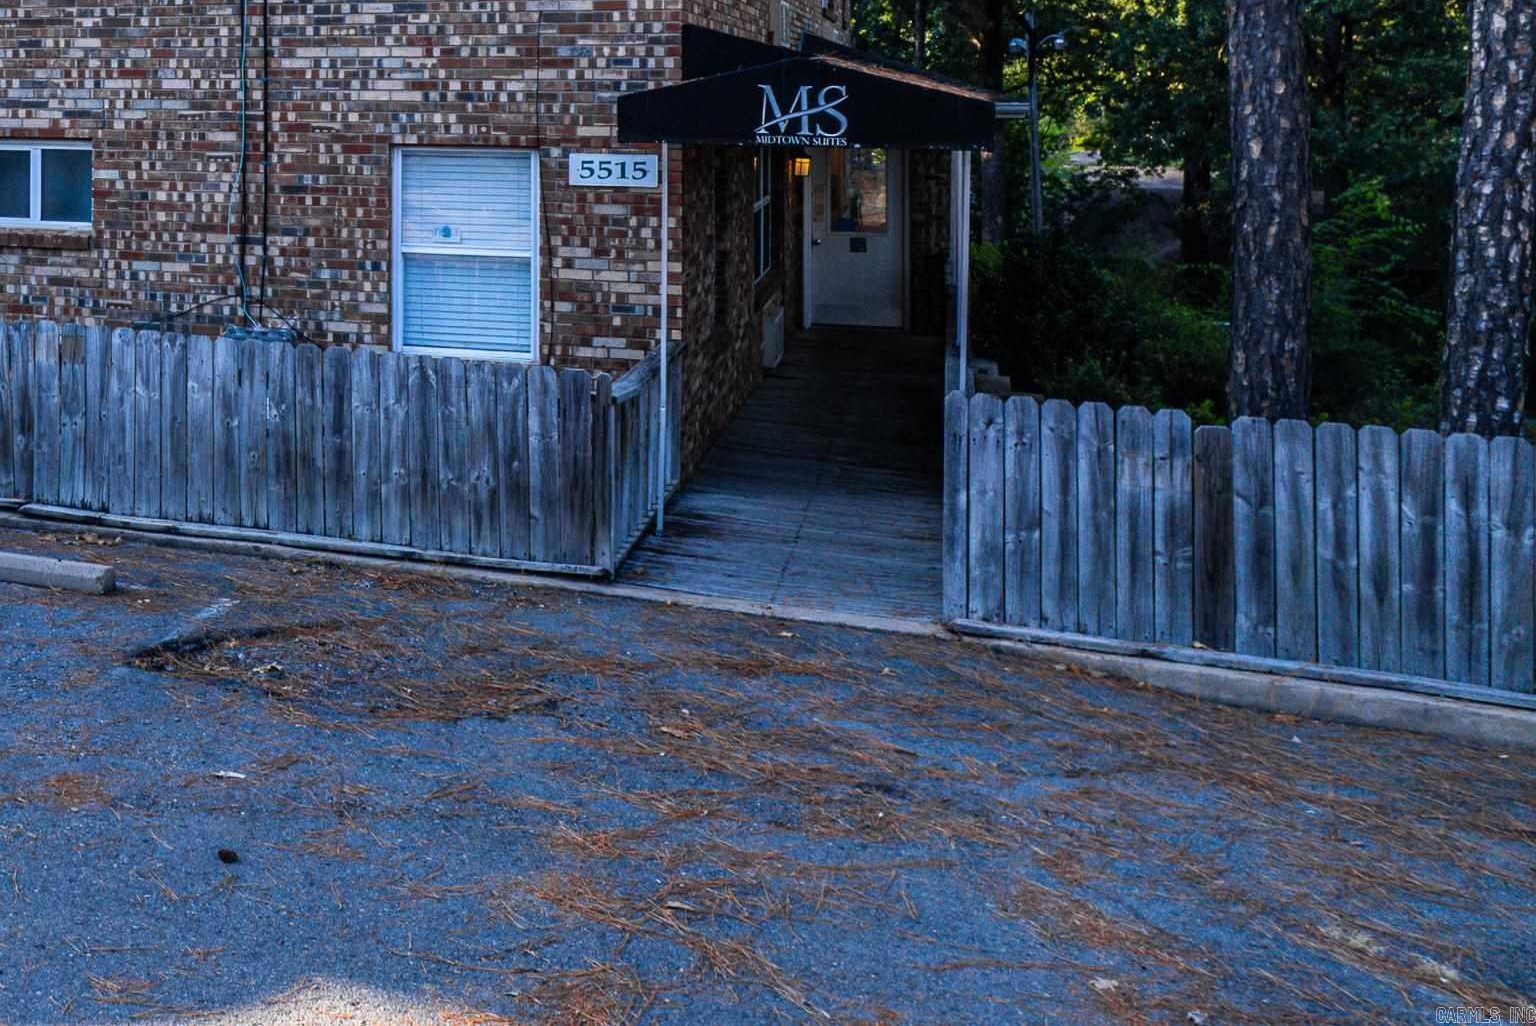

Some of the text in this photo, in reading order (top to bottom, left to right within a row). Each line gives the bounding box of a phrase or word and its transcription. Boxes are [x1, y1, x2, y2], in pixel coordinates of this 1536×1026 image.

[753, 84, 848, 136] MS
[755, 134, 848, 146] MIDTOWN SUITES
[579, 160, 647, 180] 5515
